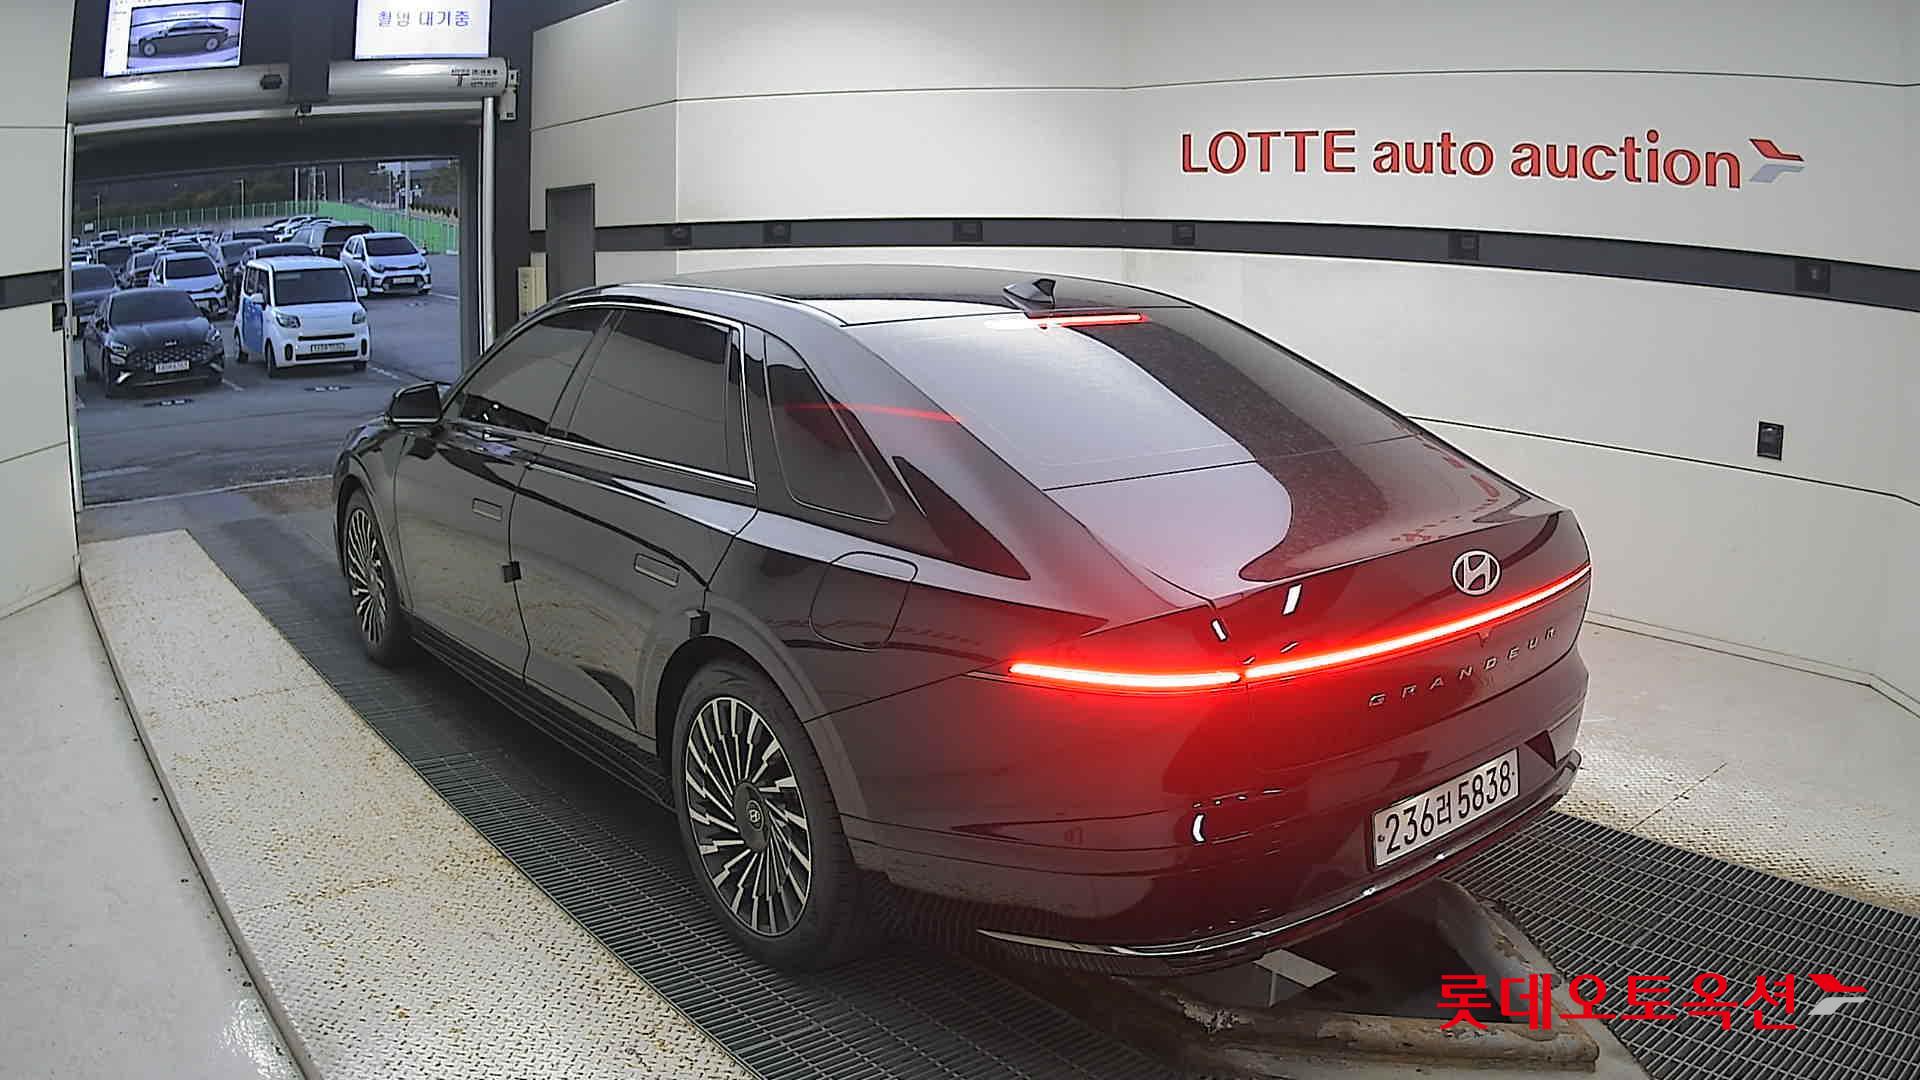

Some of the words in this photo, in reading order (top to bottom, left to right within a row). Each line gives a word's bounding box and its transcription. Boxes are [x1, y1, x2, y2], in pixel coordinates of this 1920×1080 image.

[1181, 130, 1358, 174] LOTTE
[1372, 131, 1495, 177] auto
[1510, 129, 1743, 190] auction
[1369, 627, 1556, 707] GRANDEUR
